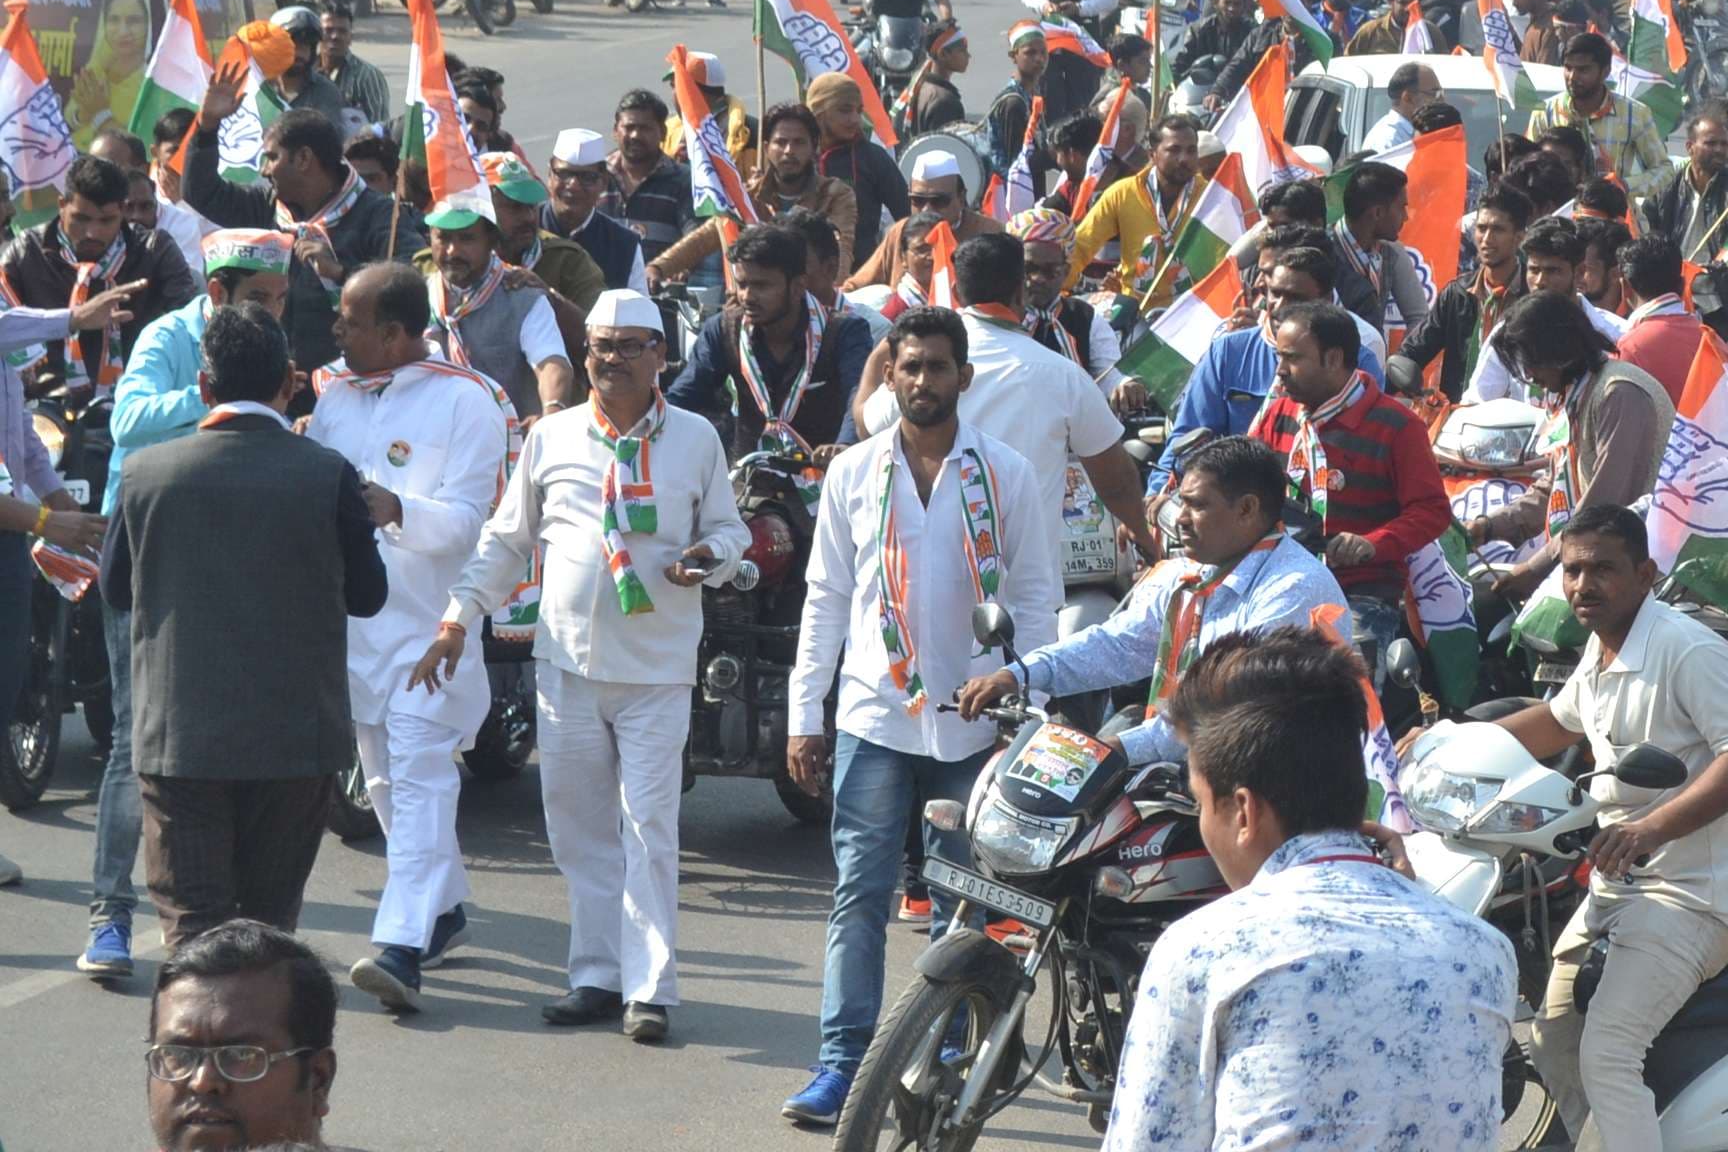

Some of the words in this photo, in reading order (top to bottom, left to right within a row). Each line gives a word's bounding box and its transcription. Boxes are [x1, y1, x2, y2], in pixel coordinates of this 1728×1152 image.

[1021, 787, 1042, 799] Hero
[1118, 843, 1162, 860] Hero
[947, 870, 1045, 921] RJ01ES3509
